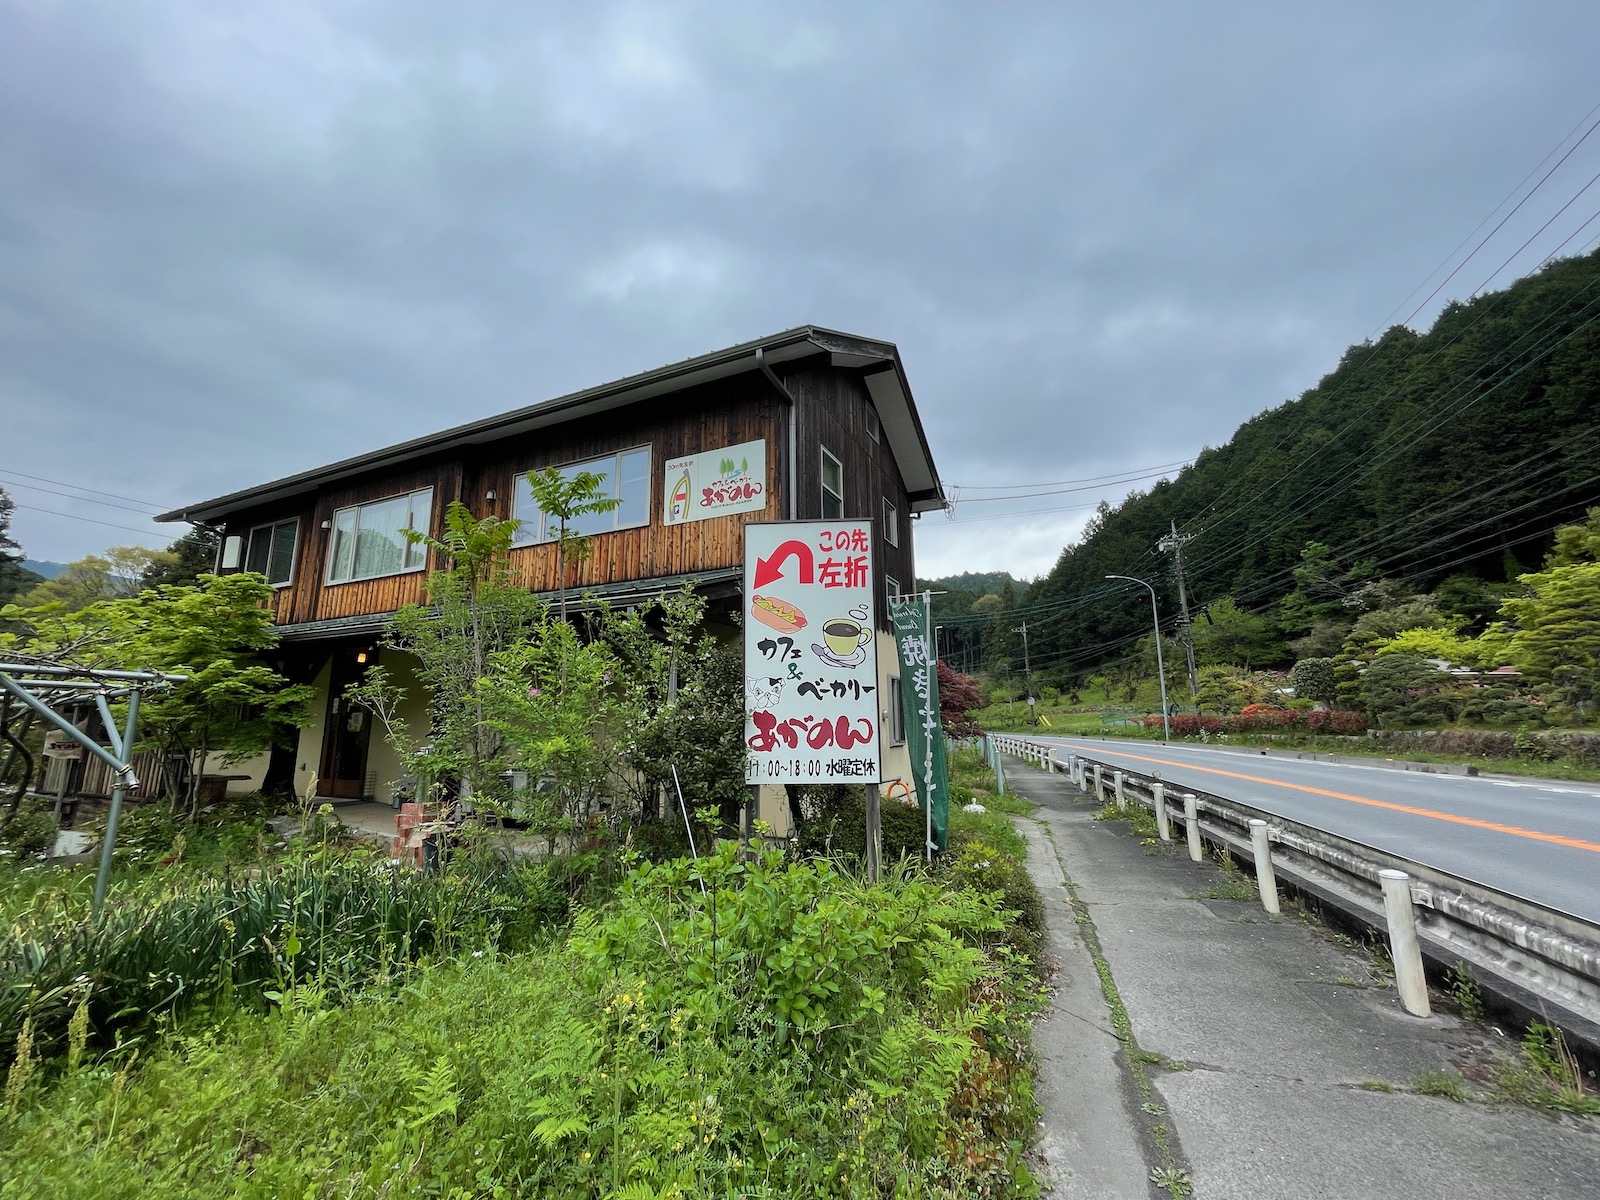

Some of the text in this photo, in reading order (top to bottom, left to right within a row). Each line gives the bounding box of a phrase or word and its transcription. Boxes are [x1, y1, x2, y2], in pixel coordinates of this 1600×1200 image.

[700, 482, 763, 507] あがのん
[818, 529, 868, 553] この先
[818, 556, 868, 588] 左折
[757, 636, 802, 663] カフェ
[786, 662, 803, 681] &
[797, 676, 876, 701] ベーカリー
[748, 710, 874, 752] あがのん
[826, 758, 876, 776] 水曜定休
